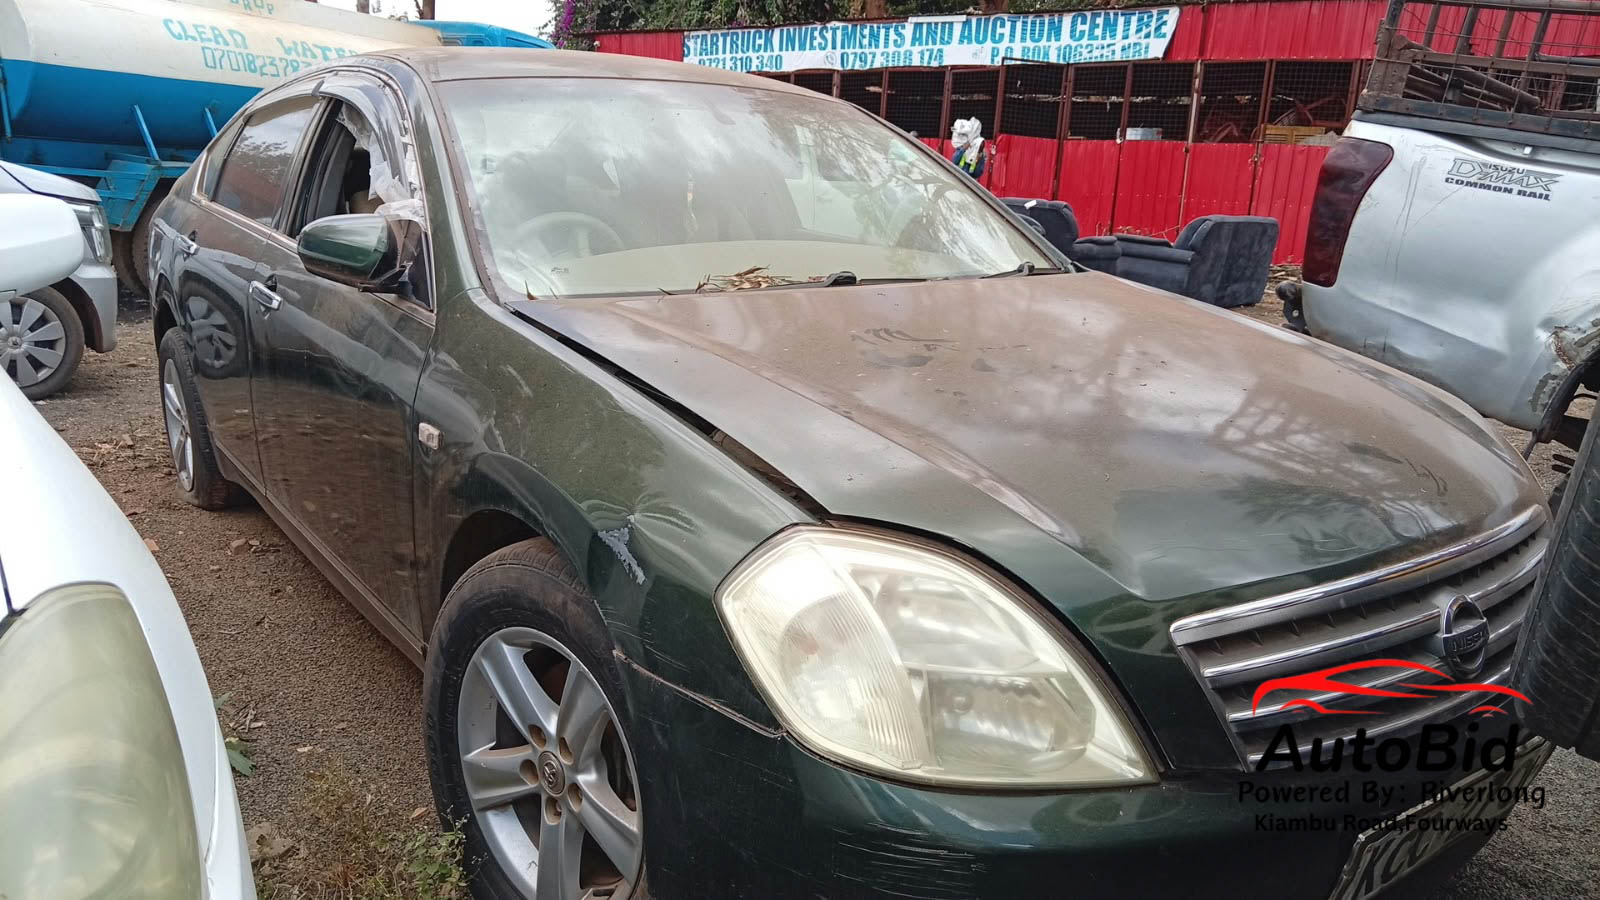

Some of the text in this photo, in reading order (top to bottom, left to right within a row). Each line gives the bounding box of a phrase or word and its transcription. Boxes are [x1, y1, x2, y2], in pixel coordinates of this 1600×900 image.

[683, 9, 1170, 58] STARTRUCK INVESTMENTS AND AUCTION CENTRE
[756, 54, 783, 71] 340
[840, 51, 876, 70] 0797
[1488, 163, 1526, 175] ISUZU
[1445, 177, 1551, 201] COMMON RAIL
